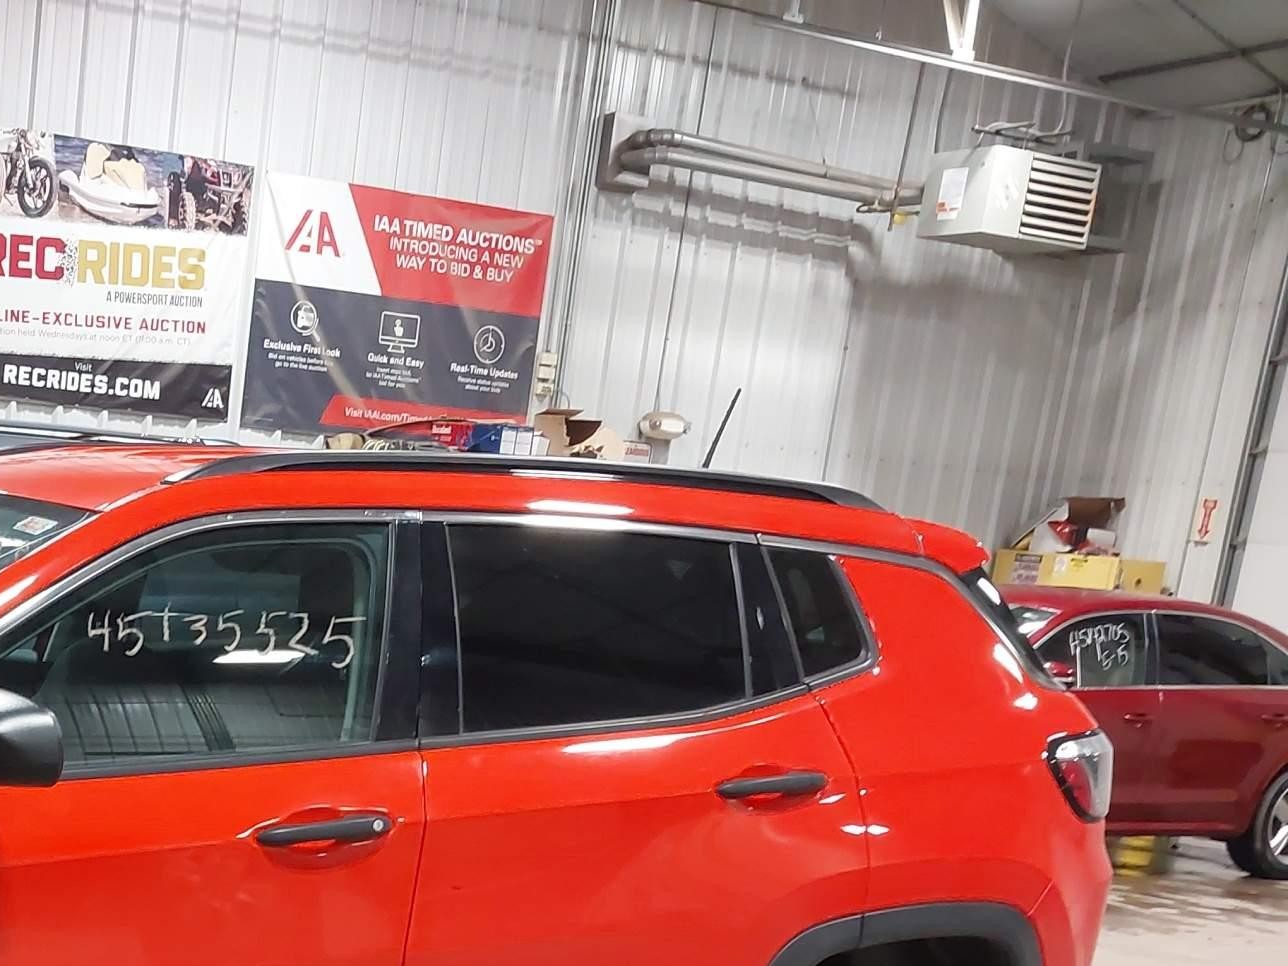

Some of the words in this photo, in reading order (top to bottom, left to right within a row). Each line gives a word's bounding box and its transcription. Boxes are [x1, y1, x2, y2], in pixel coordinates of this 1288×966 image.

[374, 214, 400, 234] IAA
[403, 219, 454, 242] TIMED
[456, 228, 535, 254] AUCTIONS
[389, 236, 478, 262] INTRODUCING
[480, 252, 490, 264] A
[493, 253, 524, 269] NEW
[77, 239, 206, 290] RIDES
[395, 253, 426, 270] WAY
[428, 258, 447, 274] TO
[450, 261, 471, 277] BID
[472, 264, 483, 279] &
[486, 267, 514, 283] BUY
[106, 290, 112, 302] A
[114, 291, 168, 305] POWERSPORT
[169, 294, 203, 308] AUCTION
[17, 327, 36, 337] held
[139, 318, 206, 334] AUCTION
[263, 338, 302, 352] Exclusive
[303, 344, 321, 355] First
[75, 361, 93, 371] Visit
[367, 352, 388, 364] Quick
[389, 356, 404, 365] and
[405, 357, 424, 369] Easy
[450, 362, 488, 376] Real-Time
[489, 367, 518, 380] Updates
[2, 363, 161, 400] RECRIDES.COM
[344, 407, 362, 417] Visit
